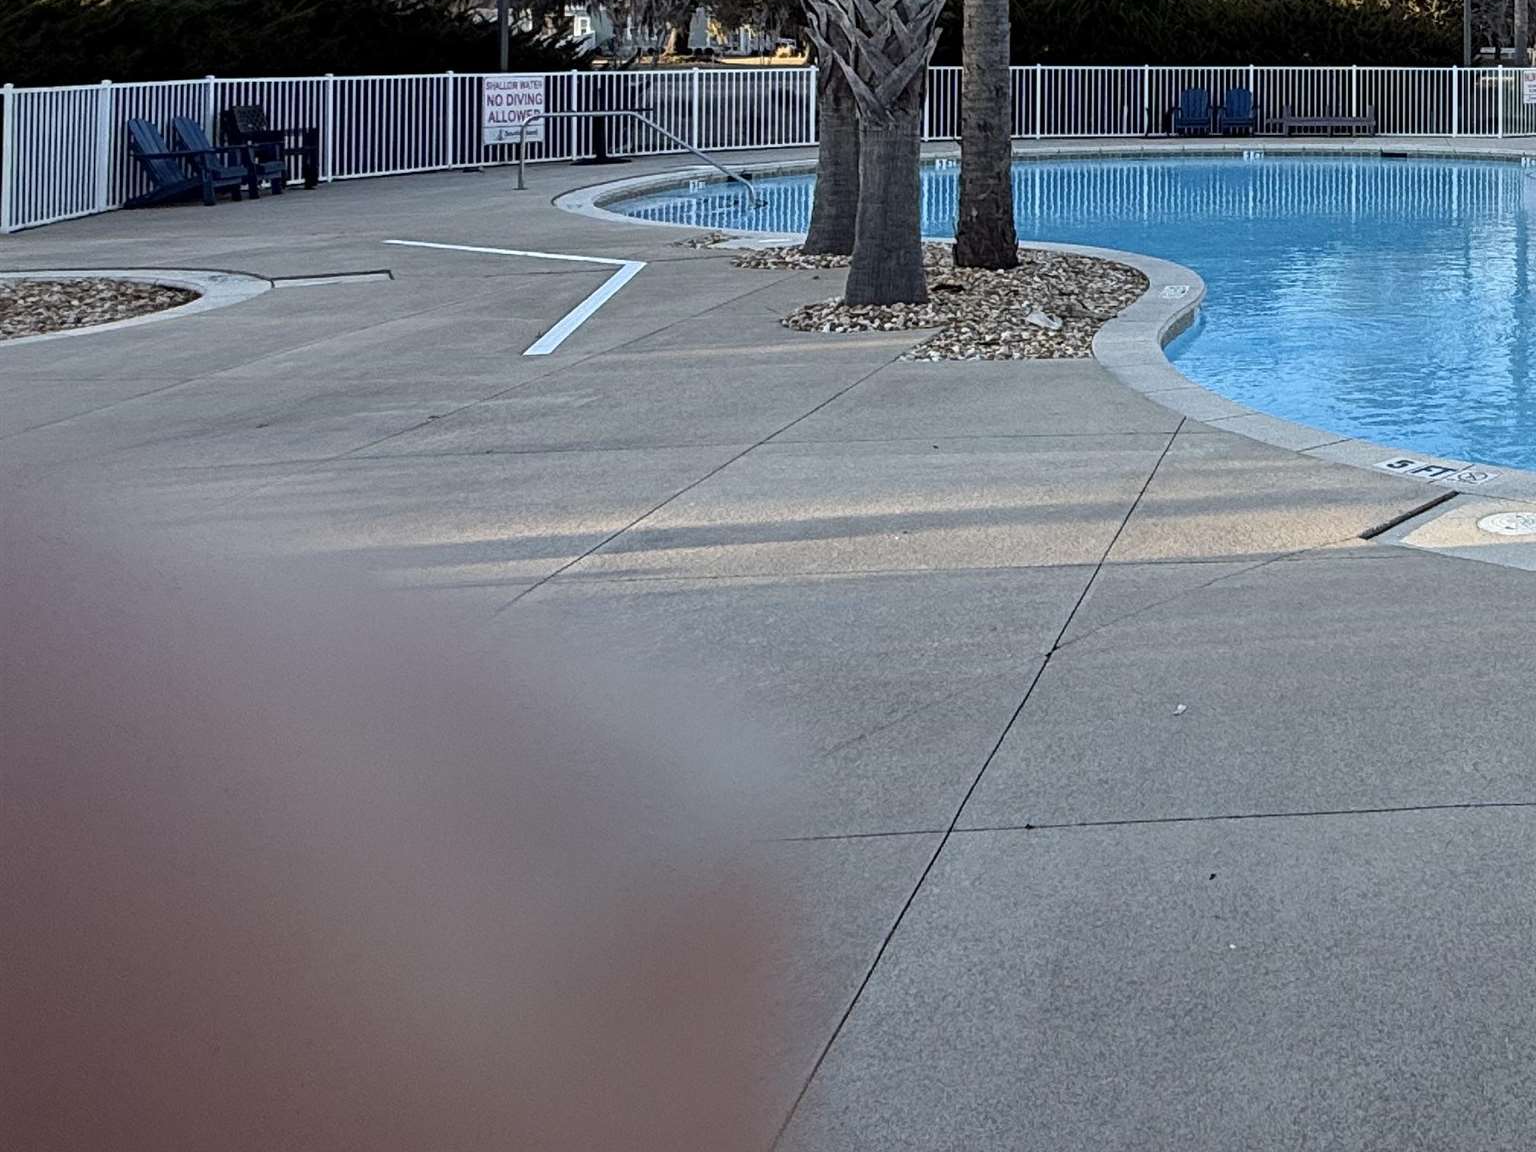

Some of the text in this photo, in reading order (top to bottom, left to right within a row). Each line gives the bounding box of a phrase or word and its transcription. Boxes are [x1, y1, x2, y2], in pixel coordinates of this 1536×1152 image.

[486, 92, 543, 107] NO DIVING
[1411, 465, 1457, 477] FT
